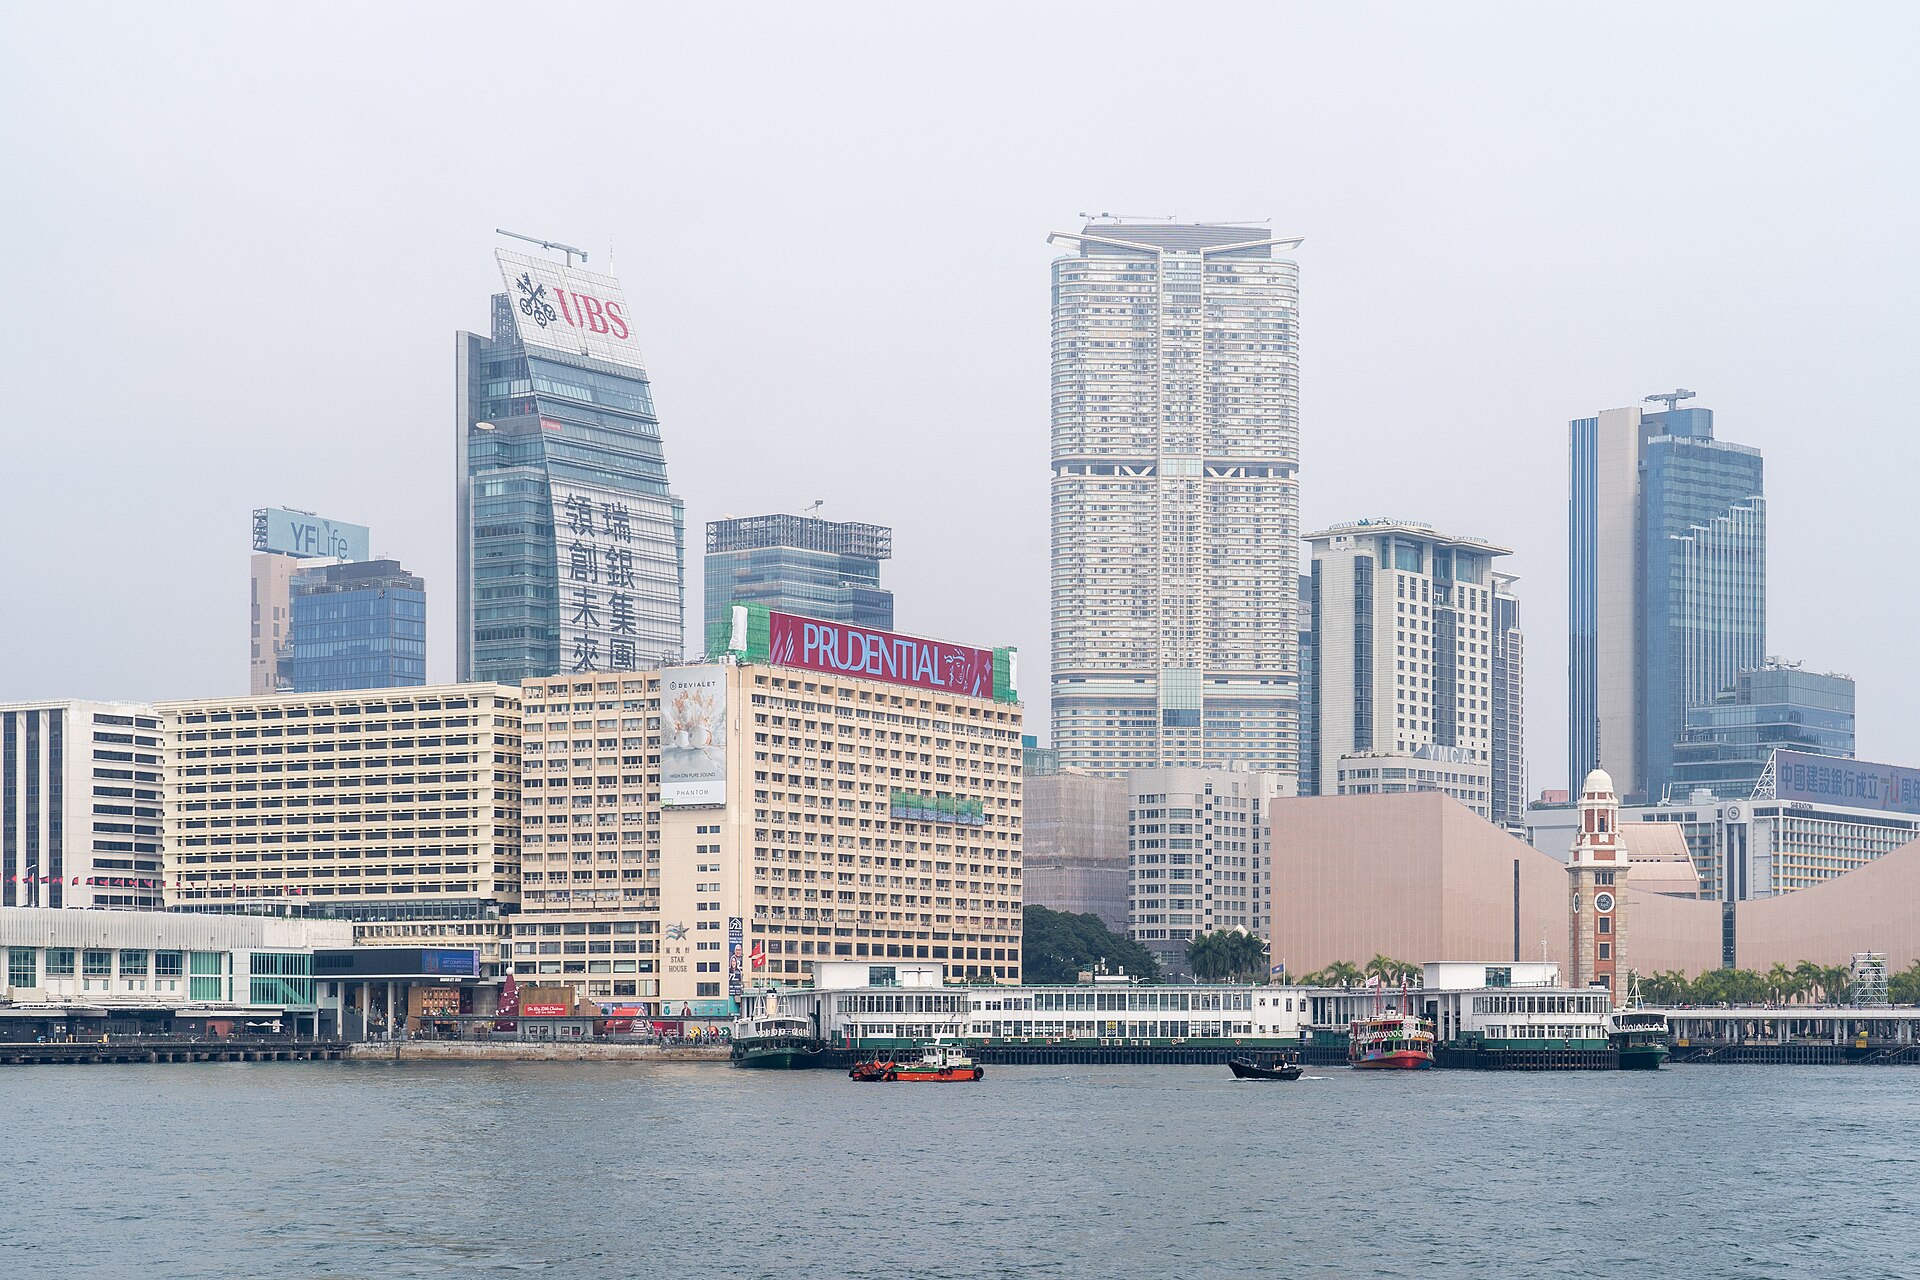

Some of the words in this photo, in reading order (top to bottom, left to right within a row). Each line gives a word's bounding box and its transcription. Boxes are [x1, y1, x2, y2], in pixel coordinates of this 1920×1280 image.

[553, 286, 629, 340] UBS
[600, 501, 637, 672] 瑞銀集團
[803, 623, 945, 685] PRUDENTIAL
[678, 681, 716, 689] DEVIALET
[1790, 801, 1814, 810] SHERATON
[668, 965, 688, 973] HOUSE
